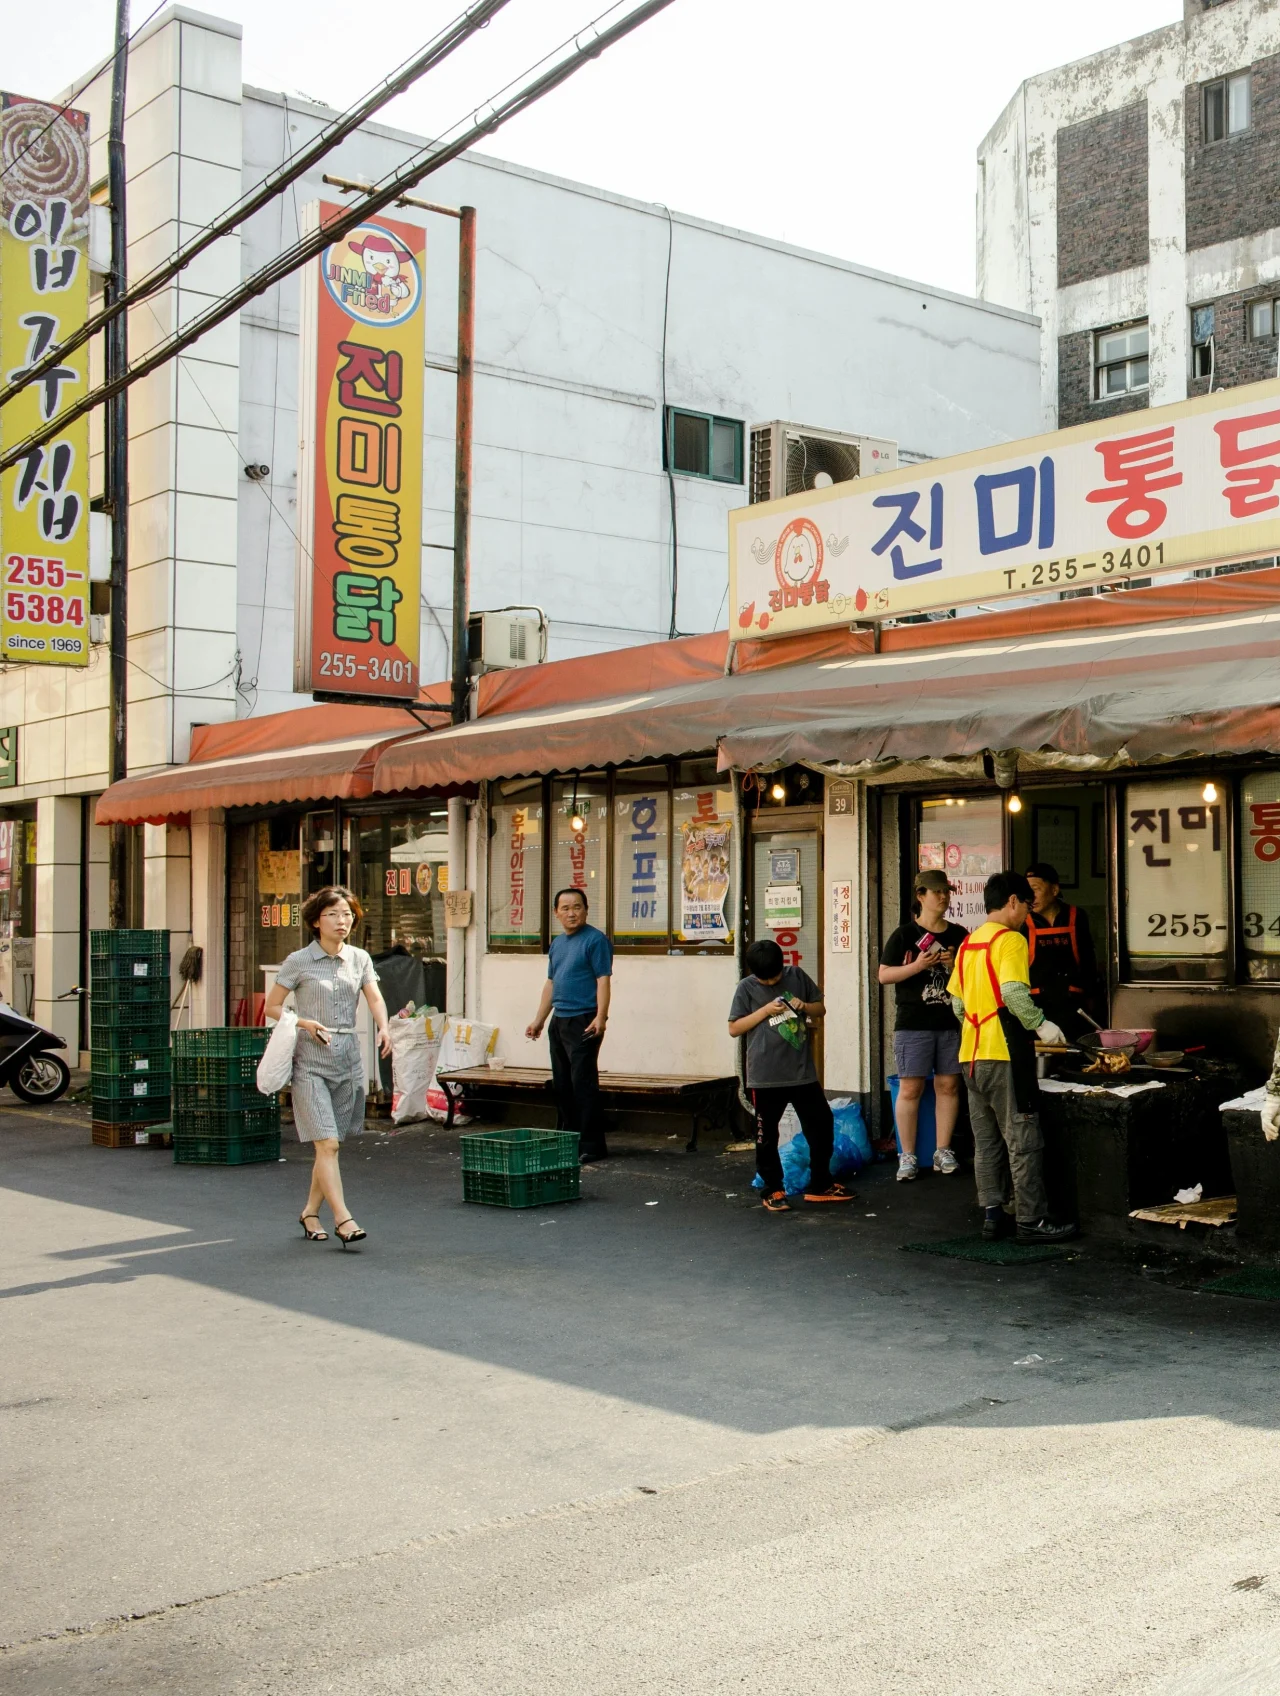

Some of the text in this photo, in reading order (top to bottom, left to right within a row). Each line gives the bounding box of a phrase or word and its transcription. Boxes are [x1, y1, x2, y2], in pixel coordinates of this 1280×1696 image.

[327, 264, 374, 289] JINMI
[341, 283, 390, 313] Fried
[880, 452, 890, 460] LG
[333, 340, 403, 646] 진미통닭
[7, 555, 83, 588] 255-
[1003, 542, 1164, 590] T.255-3401
[7, 592, 84, 626] 5384
[768, 579, 831, 613] 진미통닭
[8, 636, 82, 652] since 1969
[319, 652, 414, 684] 255-3401
[835, 798, 846, 812] 39
[632, 797, 657, 894] 호프
[1131, 805, 1221, 867] 진미
[386, 868, 412, 896] 진미
[510, 814, 525, 926] 후라이드치킨
[631, 901, 657, 919] HOF
[840, 885, 851, 949] 정기휴일
